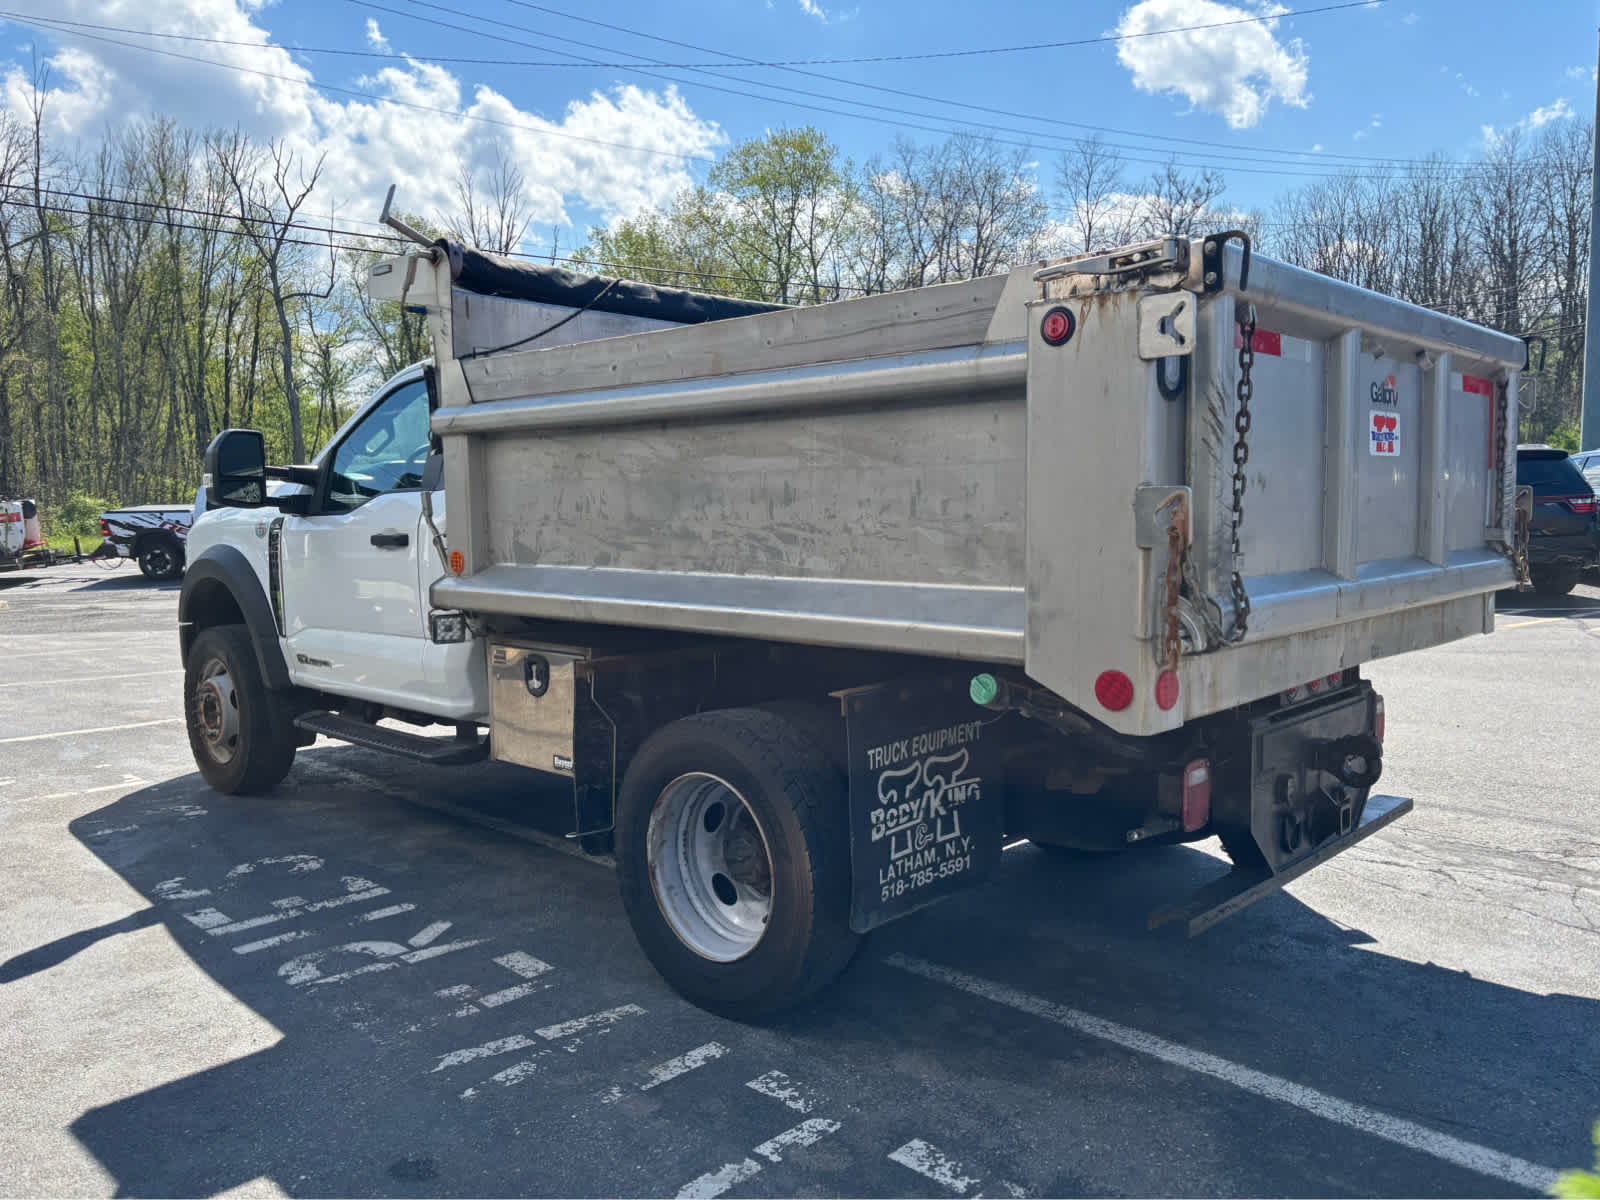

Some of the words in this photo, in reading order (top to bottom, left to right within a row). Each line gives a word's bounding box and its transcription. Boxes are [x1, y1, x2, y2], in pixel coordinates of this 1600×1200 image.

[867, 740, 909, 770] TRUCK
[911, 720, 982, 757] EQUIPMENT
[880, 848, 940, 885] LATHAM,
[945, 836, 975, 857] N.Y.
[881, 855, 971, 902] 518-785-5591
